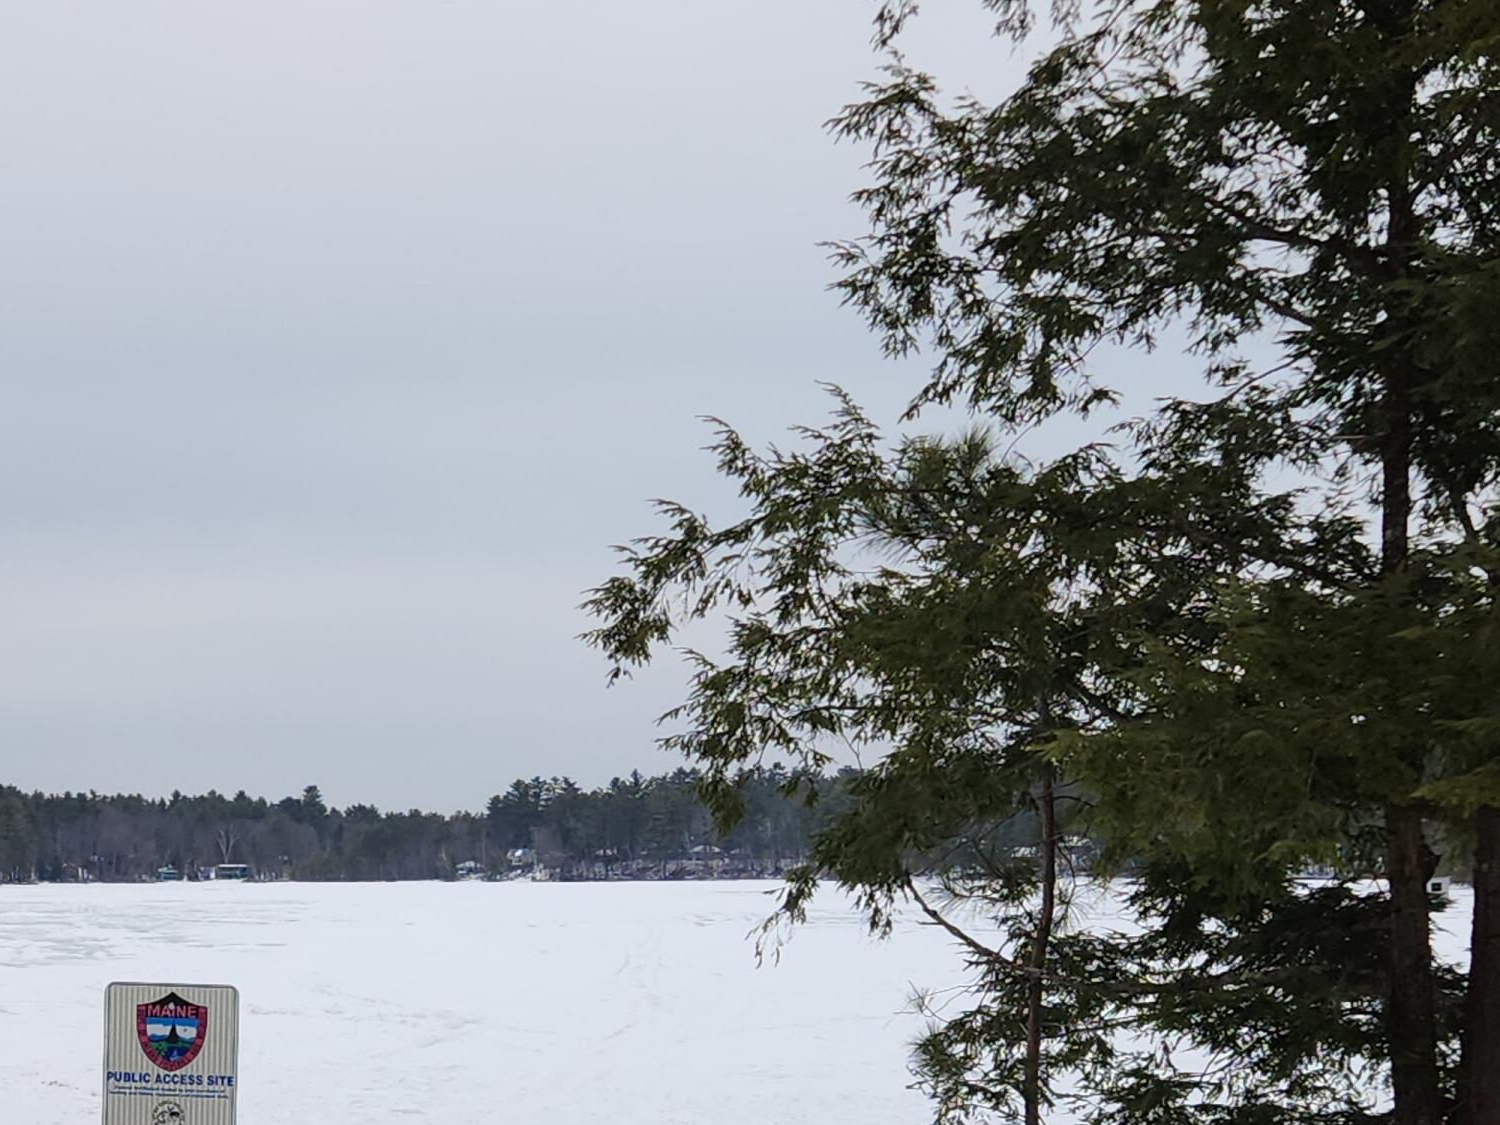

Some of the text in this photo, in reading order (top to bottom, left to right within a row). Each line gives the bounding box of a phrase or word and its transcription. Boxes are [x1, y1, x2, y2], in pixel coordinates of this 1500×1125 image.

[148, 1004, 197, 1017] MAINE
[107, 1071, 234, 1087] PUBLIC ACCESS SITE
